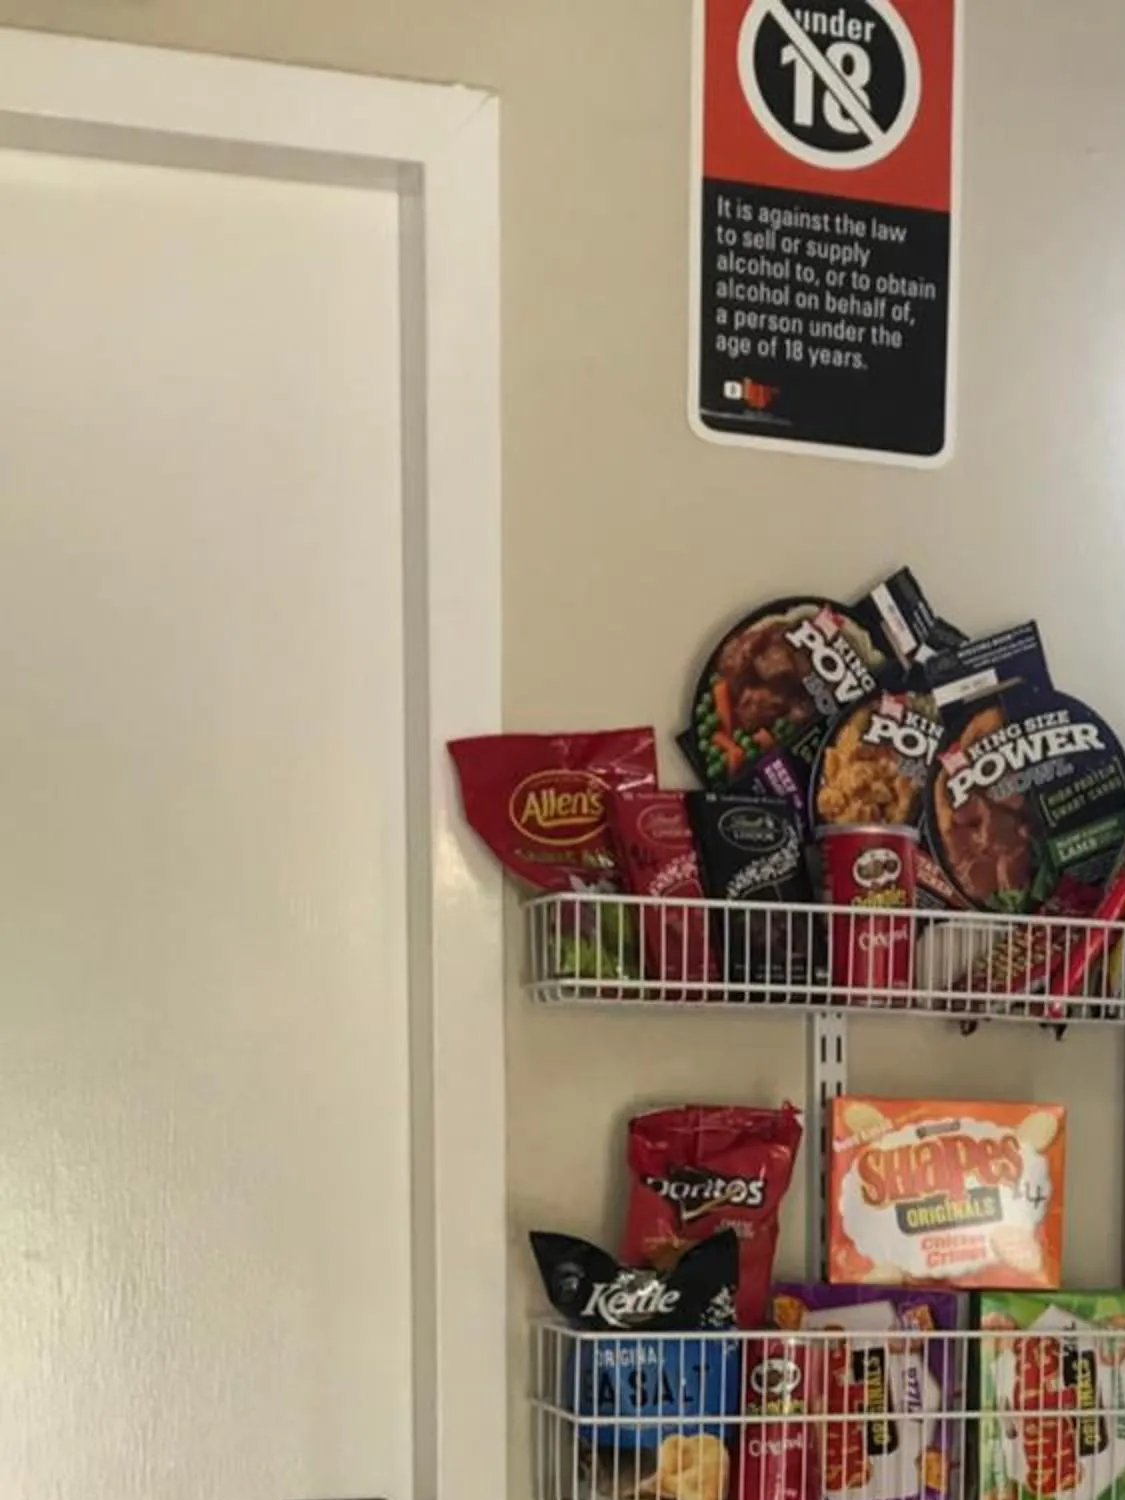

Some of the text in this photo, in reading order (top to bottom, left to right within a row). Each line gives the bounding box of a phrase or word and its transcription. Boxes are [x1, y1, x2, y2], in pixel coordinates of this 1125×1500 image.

[794, 7, 876, 43] under
[780, 41, 872, 135] 18
[717, 195, 908, 243] It is against the law
[716, 225, 871, 268] to sell or supply
[716, 251, 937, 299] alcohol to, or to obtain
[715, 277, 917, 327] alcohol on behalf of,
[715, 307, 902, 349] a person under the
[715, 333, 869, 371] age of 18 years.
[832, 637, 877, 693] KING
[863, 713, 938, 767] PO
[905, 711, 946, 738] KIN
[968, 709, 1072, 761] KING SIZE
[947, 722, 1106, 809] POWER
[520, 788, 605, 827] Allen's
[906, 1198, 996, 1228] ORIGINALS
[581, 1279, 681, 1328] Kettle
